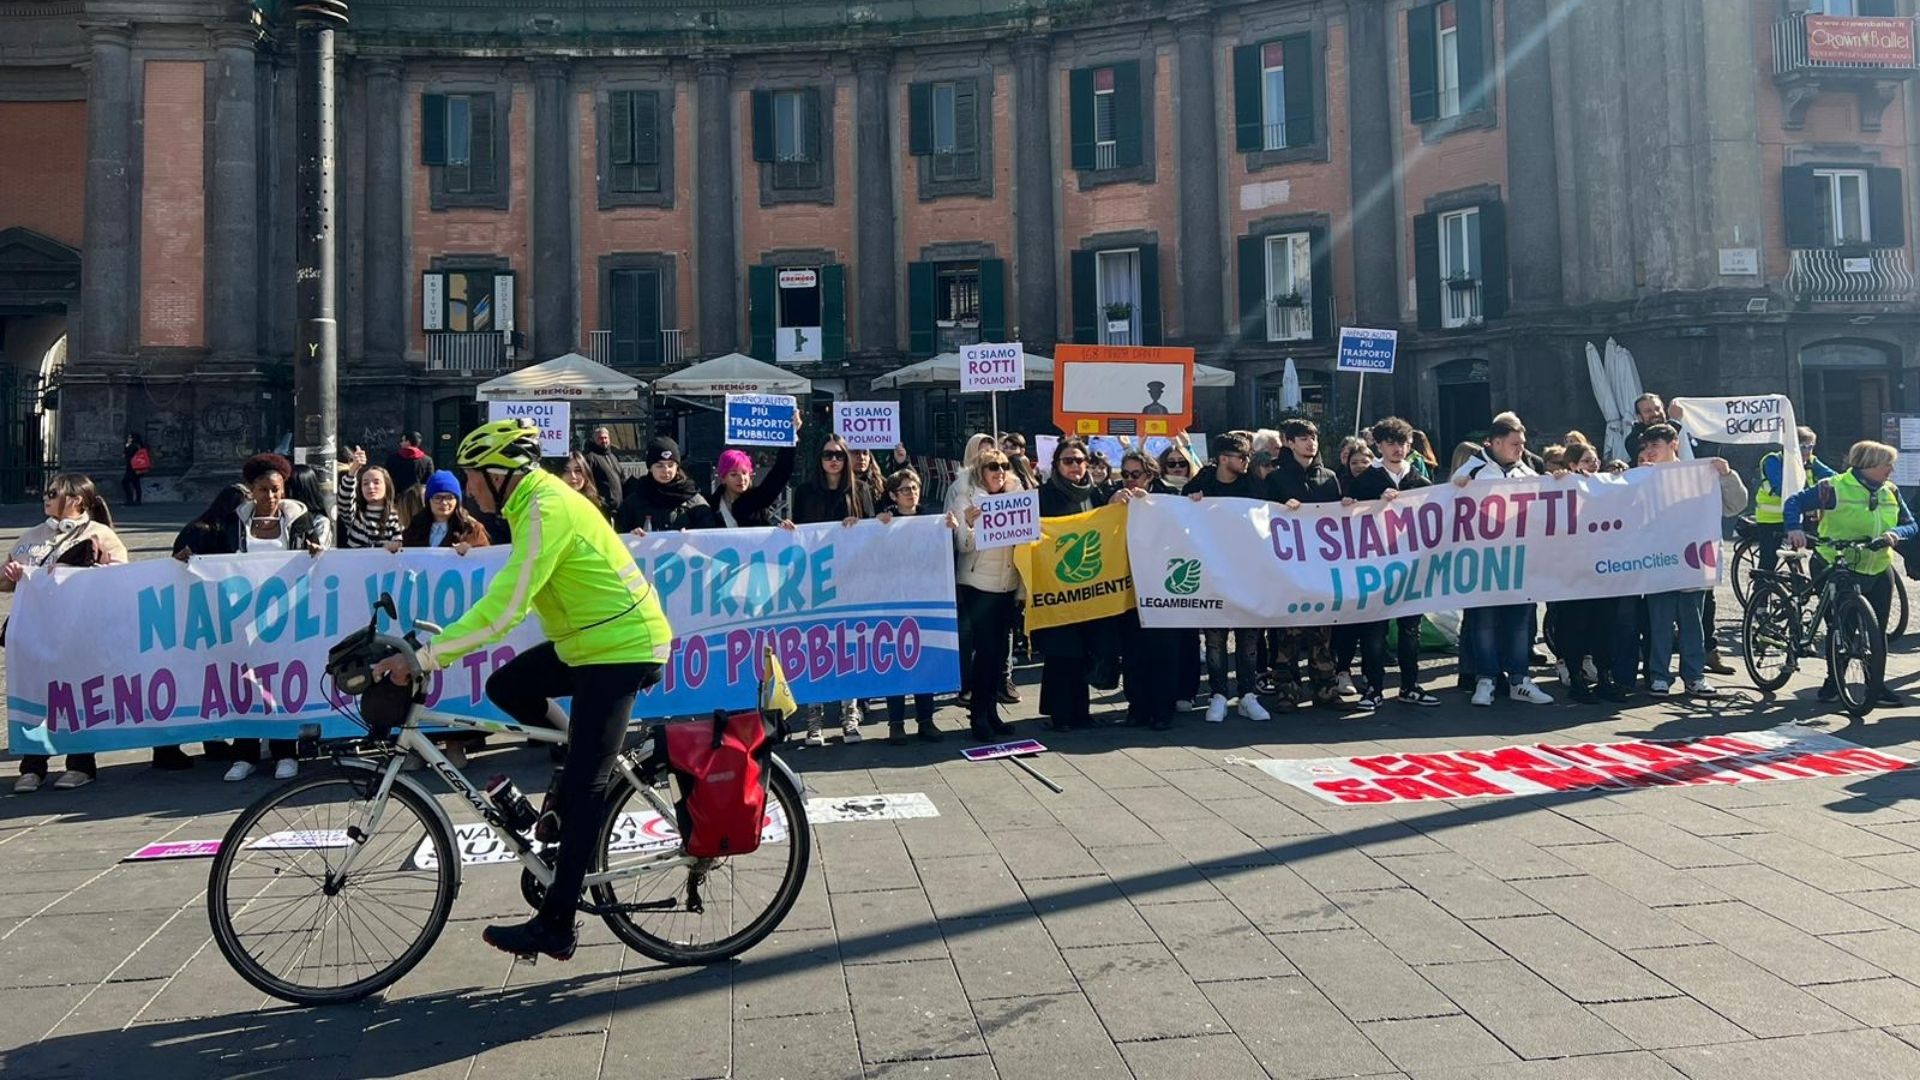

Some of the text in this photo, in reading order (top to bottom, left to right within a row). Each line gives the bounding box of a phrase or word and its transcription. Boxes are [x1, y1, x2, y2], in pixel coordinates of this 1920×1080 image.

[1870, 30, 1909, 49] Ballet
[308, 343, 319, 357] Y
[967, 349, 1016, 360] CI SIAMO
[1343, 348, 1391, 359] TRASPORTO
[969, 359, 1015, 374] ROTTI
[1346, 358, 1385, 368] PUBBLICO
[974, 376, 1016, 385] POLMONI
[506, 405, 553, 415] NAPOLI
[751, 405, 768, 416] PIÙ
[841, 407, 892, 417] CI SIAMO
[1725, 398, 1780, 414] PENSATI
[731, 417, 791, 429] TRASPORTO
[842, 418, 891, 432] ROTTI
[736, 429, 786, 440] PUBBLICO
[849, 436, 892, 444] POLMONI
[981, 496, 1032, 513] CI SIAMO
[982, 508, 1032, 530] ROTTI
[1270, 489, 1623, 562] CI SIAMO ROTTI...
[989, 528, 1032, 541] POLMONI
[1595, 551, 1679, 575] CleanCities
[1356, 545, 1526, 611] POLMONI
[1032, 575, 1133, 608] EGAMBIENTE
[1139, 597, 1224, 610] LEGAMBIENTE
[47, 668, 176, 733] MENO
[200, 659, 308, 720] AUTO
